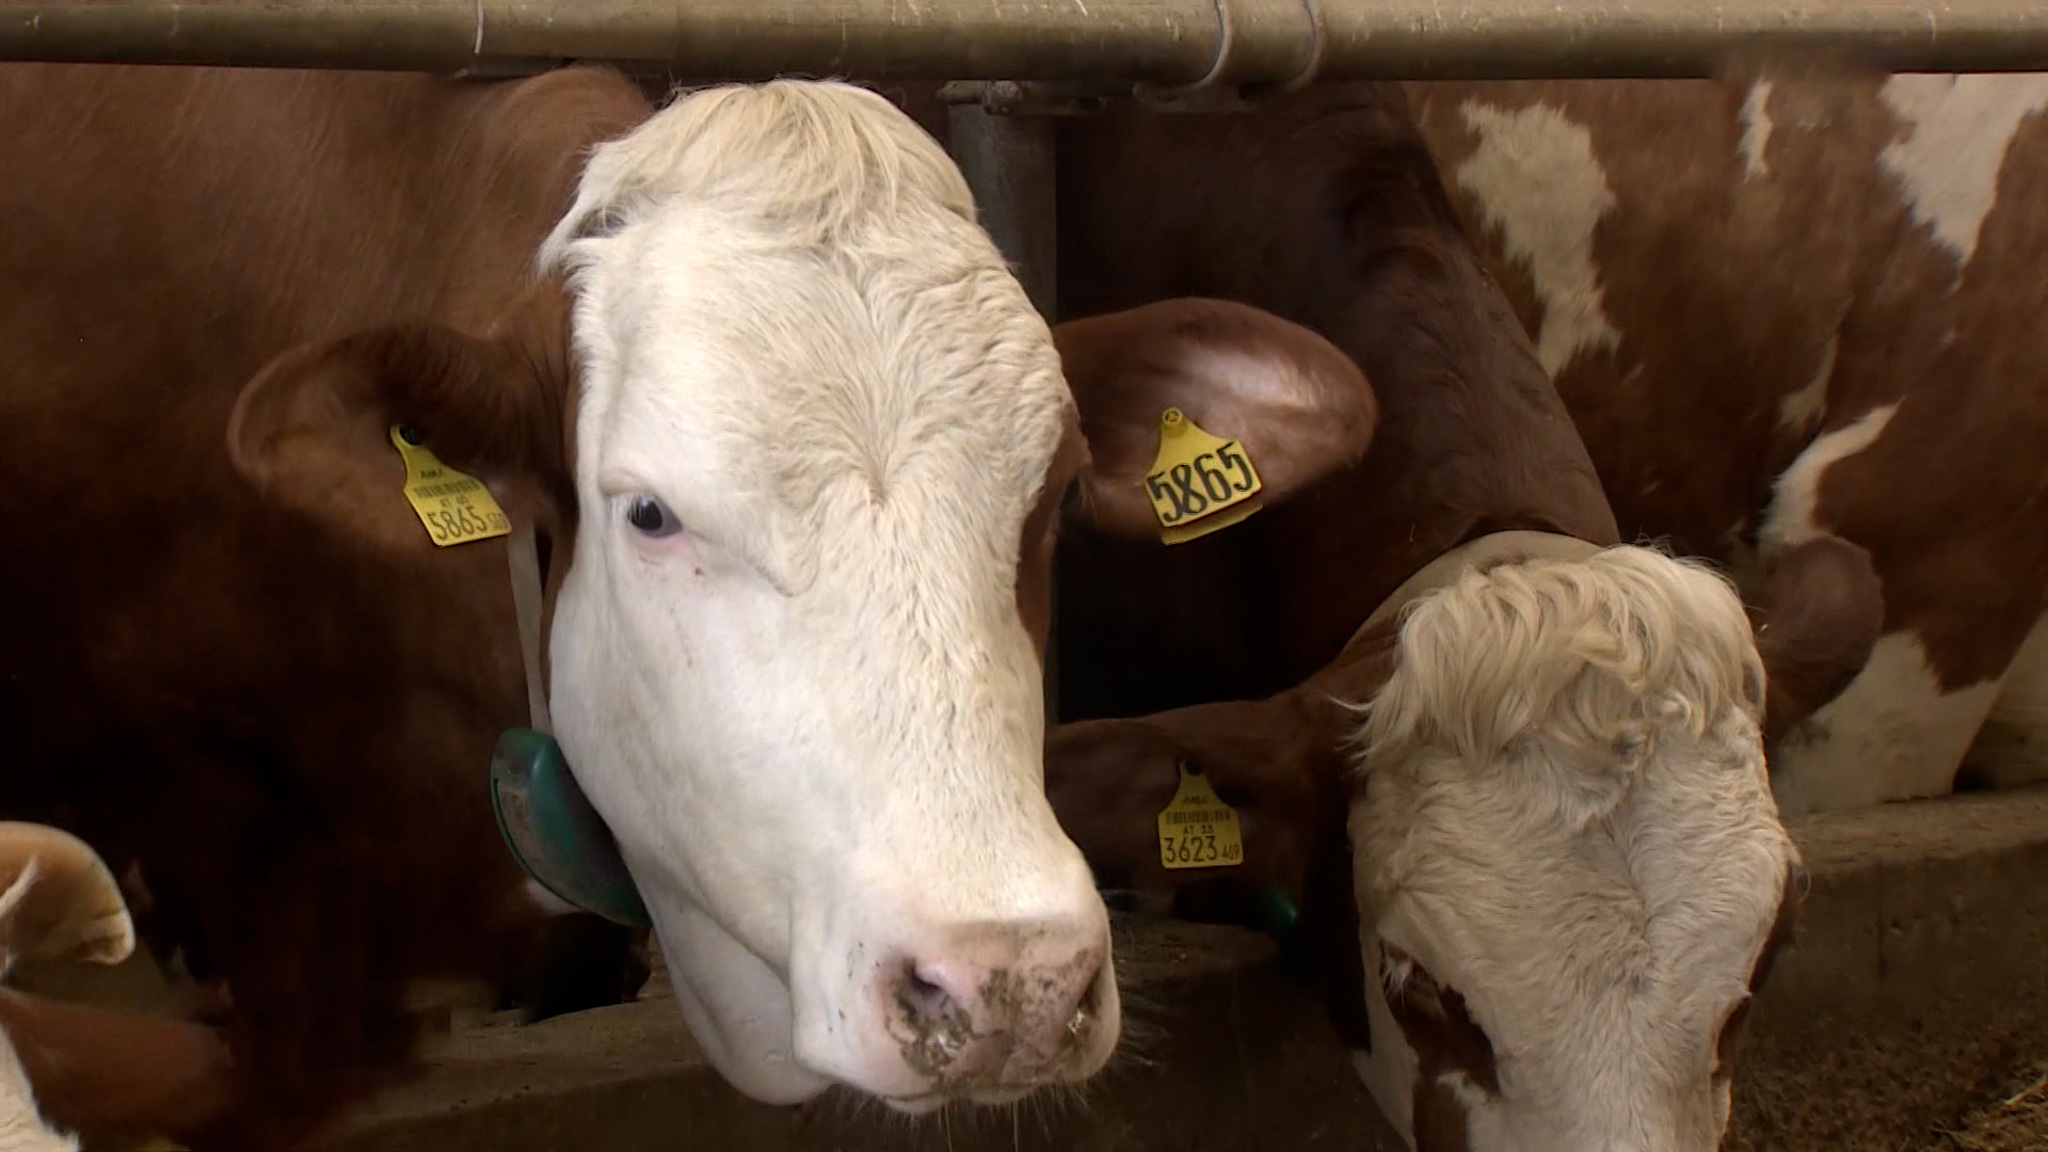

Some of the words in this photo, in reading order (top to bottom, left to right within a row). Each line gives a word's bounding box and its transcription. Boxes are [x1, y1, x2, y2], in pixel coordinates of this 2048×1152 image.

[1146, 441, 1253, 523] 5865
[427, 506, 487, 541] 5865
[1183, 823, 1195, 835] AT
[1163, 835, 1218, 863] 3623
